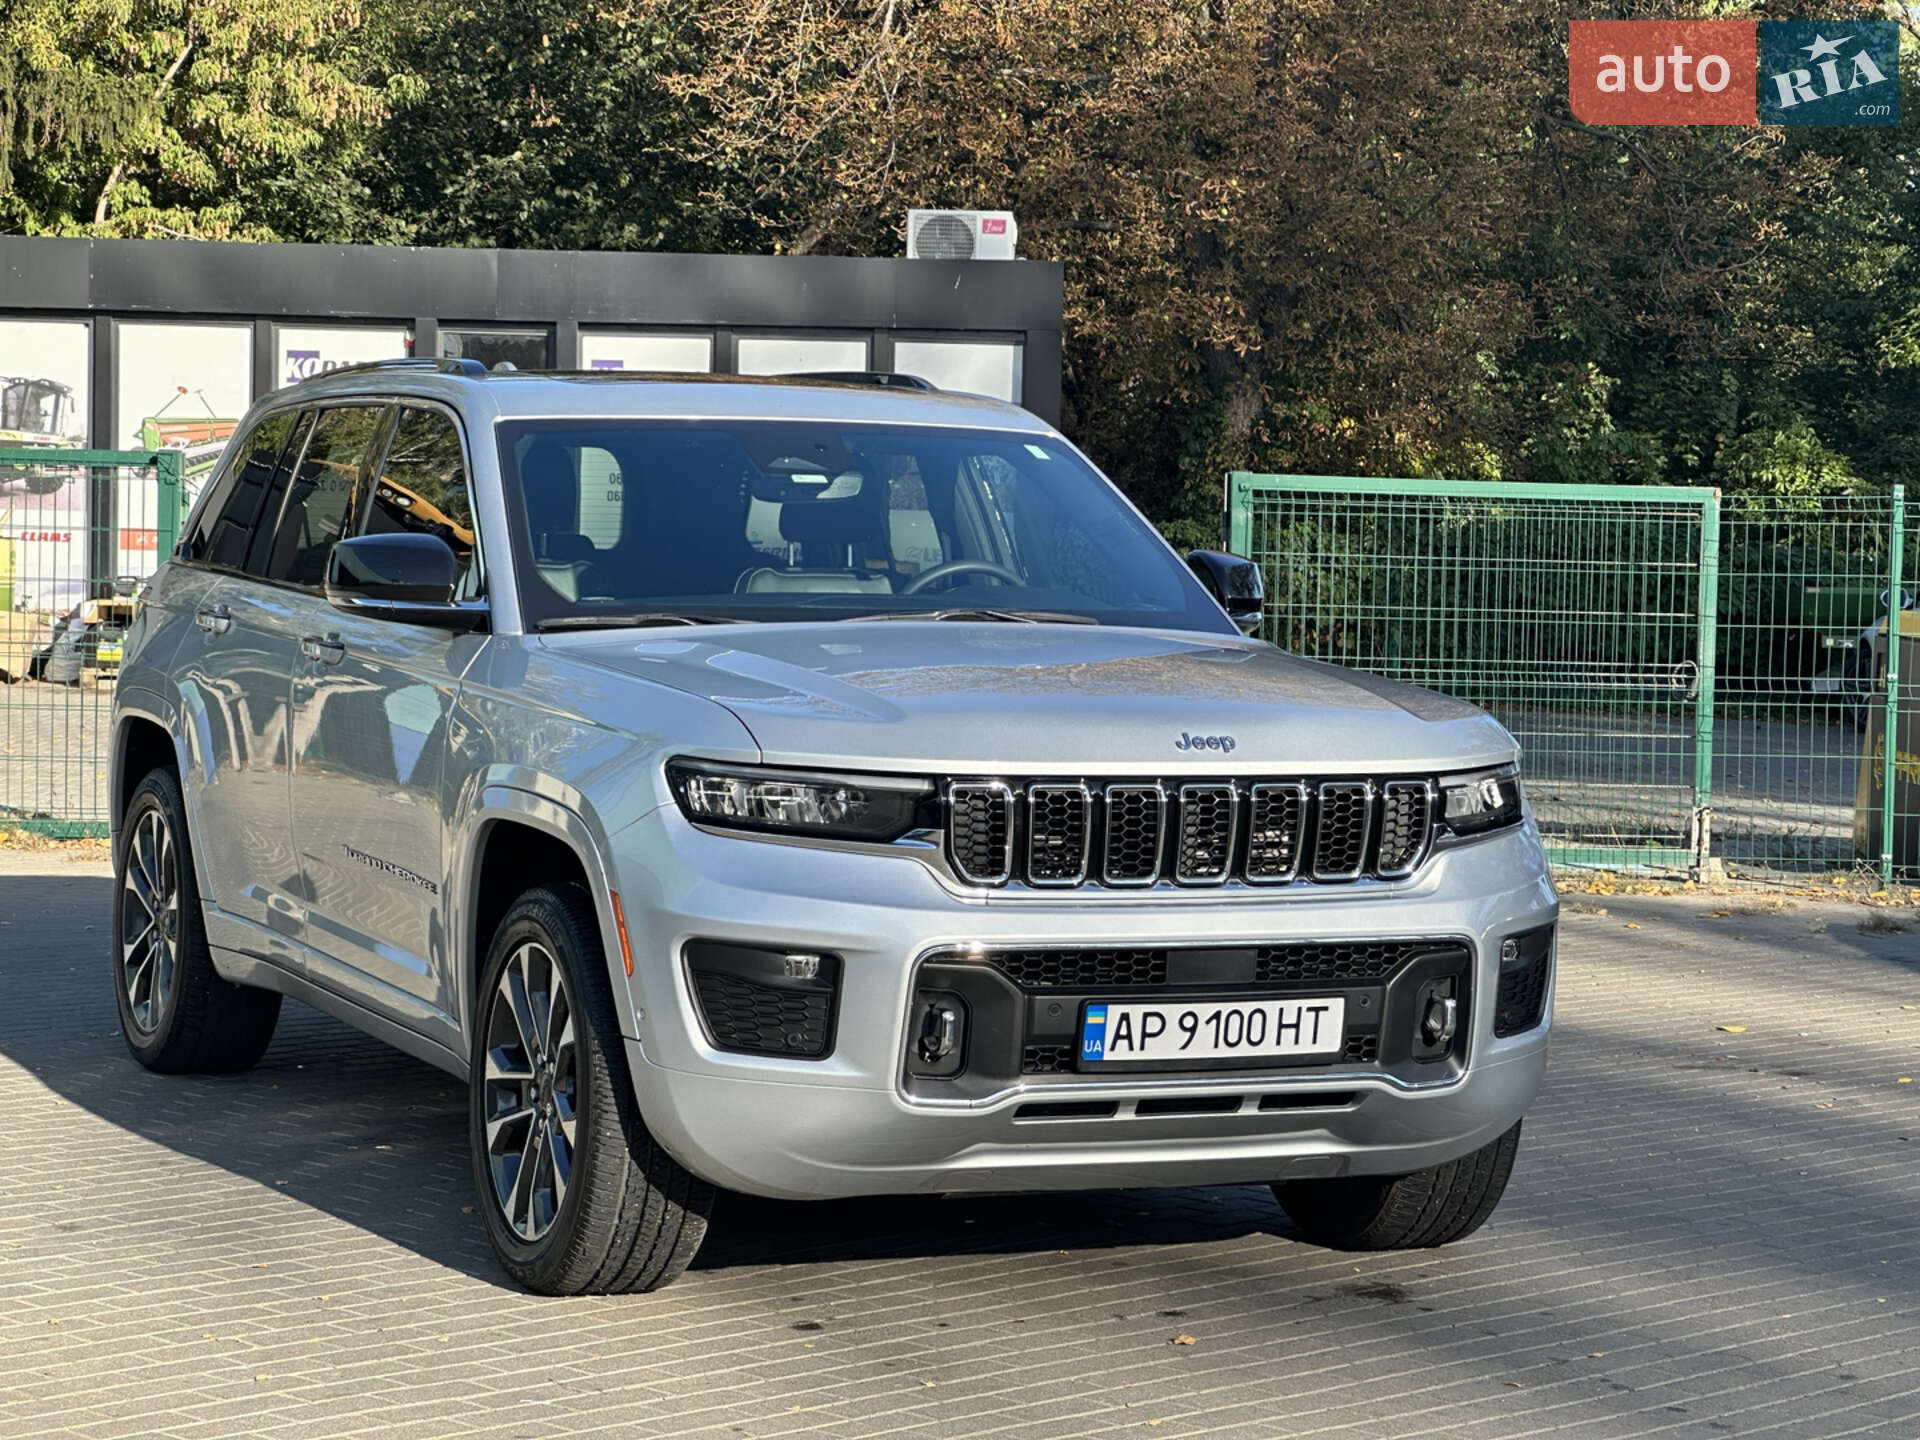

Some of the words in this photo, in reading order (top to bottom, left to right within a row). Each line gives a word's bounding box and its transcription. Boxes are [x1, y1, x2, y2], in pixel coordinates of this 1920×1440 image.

[1175, 732, 1236, 753] Jeep
[1084, 1040, 1103, 1053] UA
[1109, 1011, 1166, 1051] AP
[1178, 1008, 1267, 1050] 9100
[1276, 1006, 1329, 1046] HT
